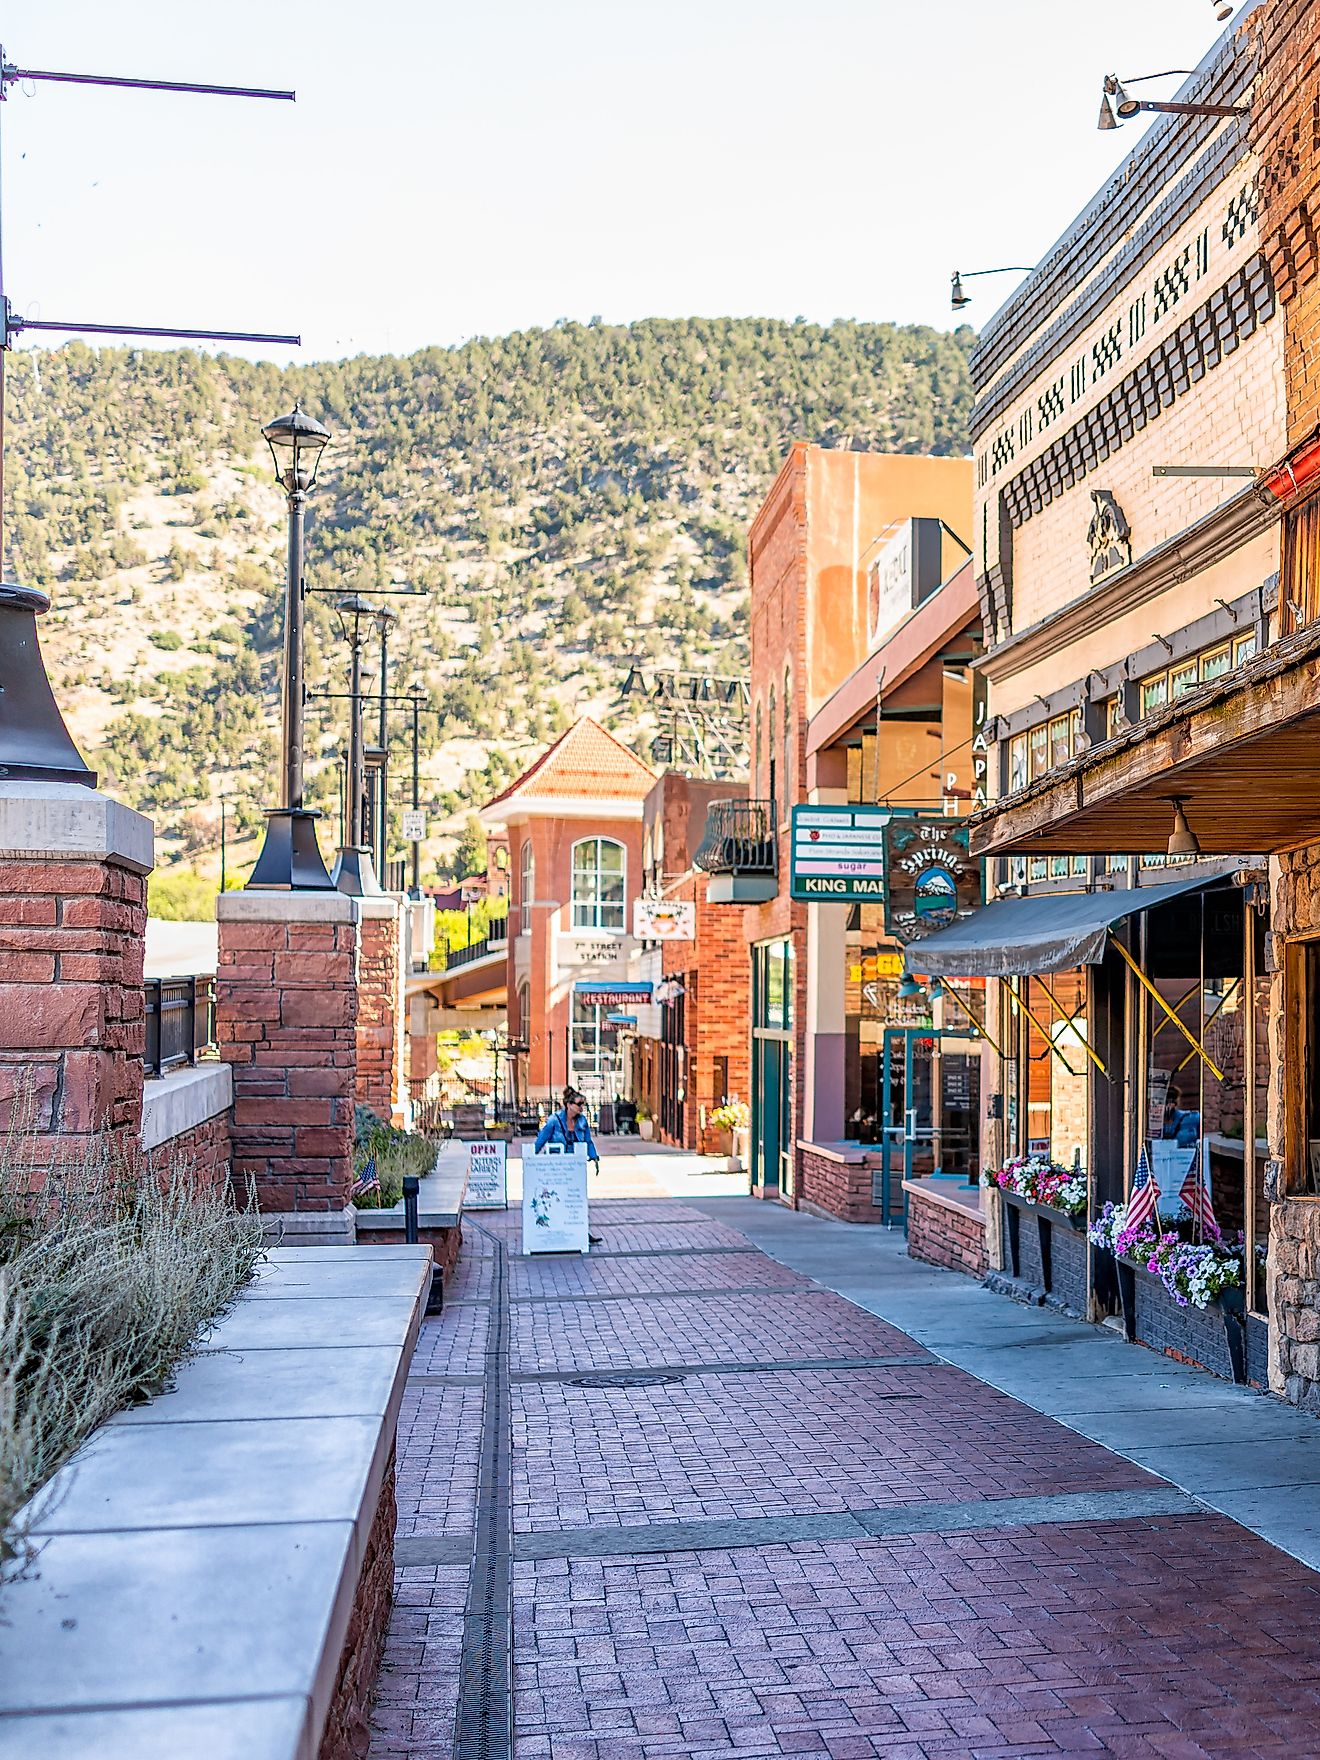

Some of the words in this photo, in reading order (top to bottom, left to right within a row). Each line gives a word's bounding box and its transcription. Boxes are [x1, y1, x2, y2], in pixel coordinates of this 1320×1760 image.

[406, 826, 422, 838] 25
[920, 826, 948, 842] The
[901, 844, 964, 876] Springs
[838, 862, 867, 871] sugar
[805, 878, 847, 893] KING
[580, 952, 618, 960] STATION
[583, 992, 650, 1004] RESTAURANT
[471, 1143, 496, 1154] OPEN
